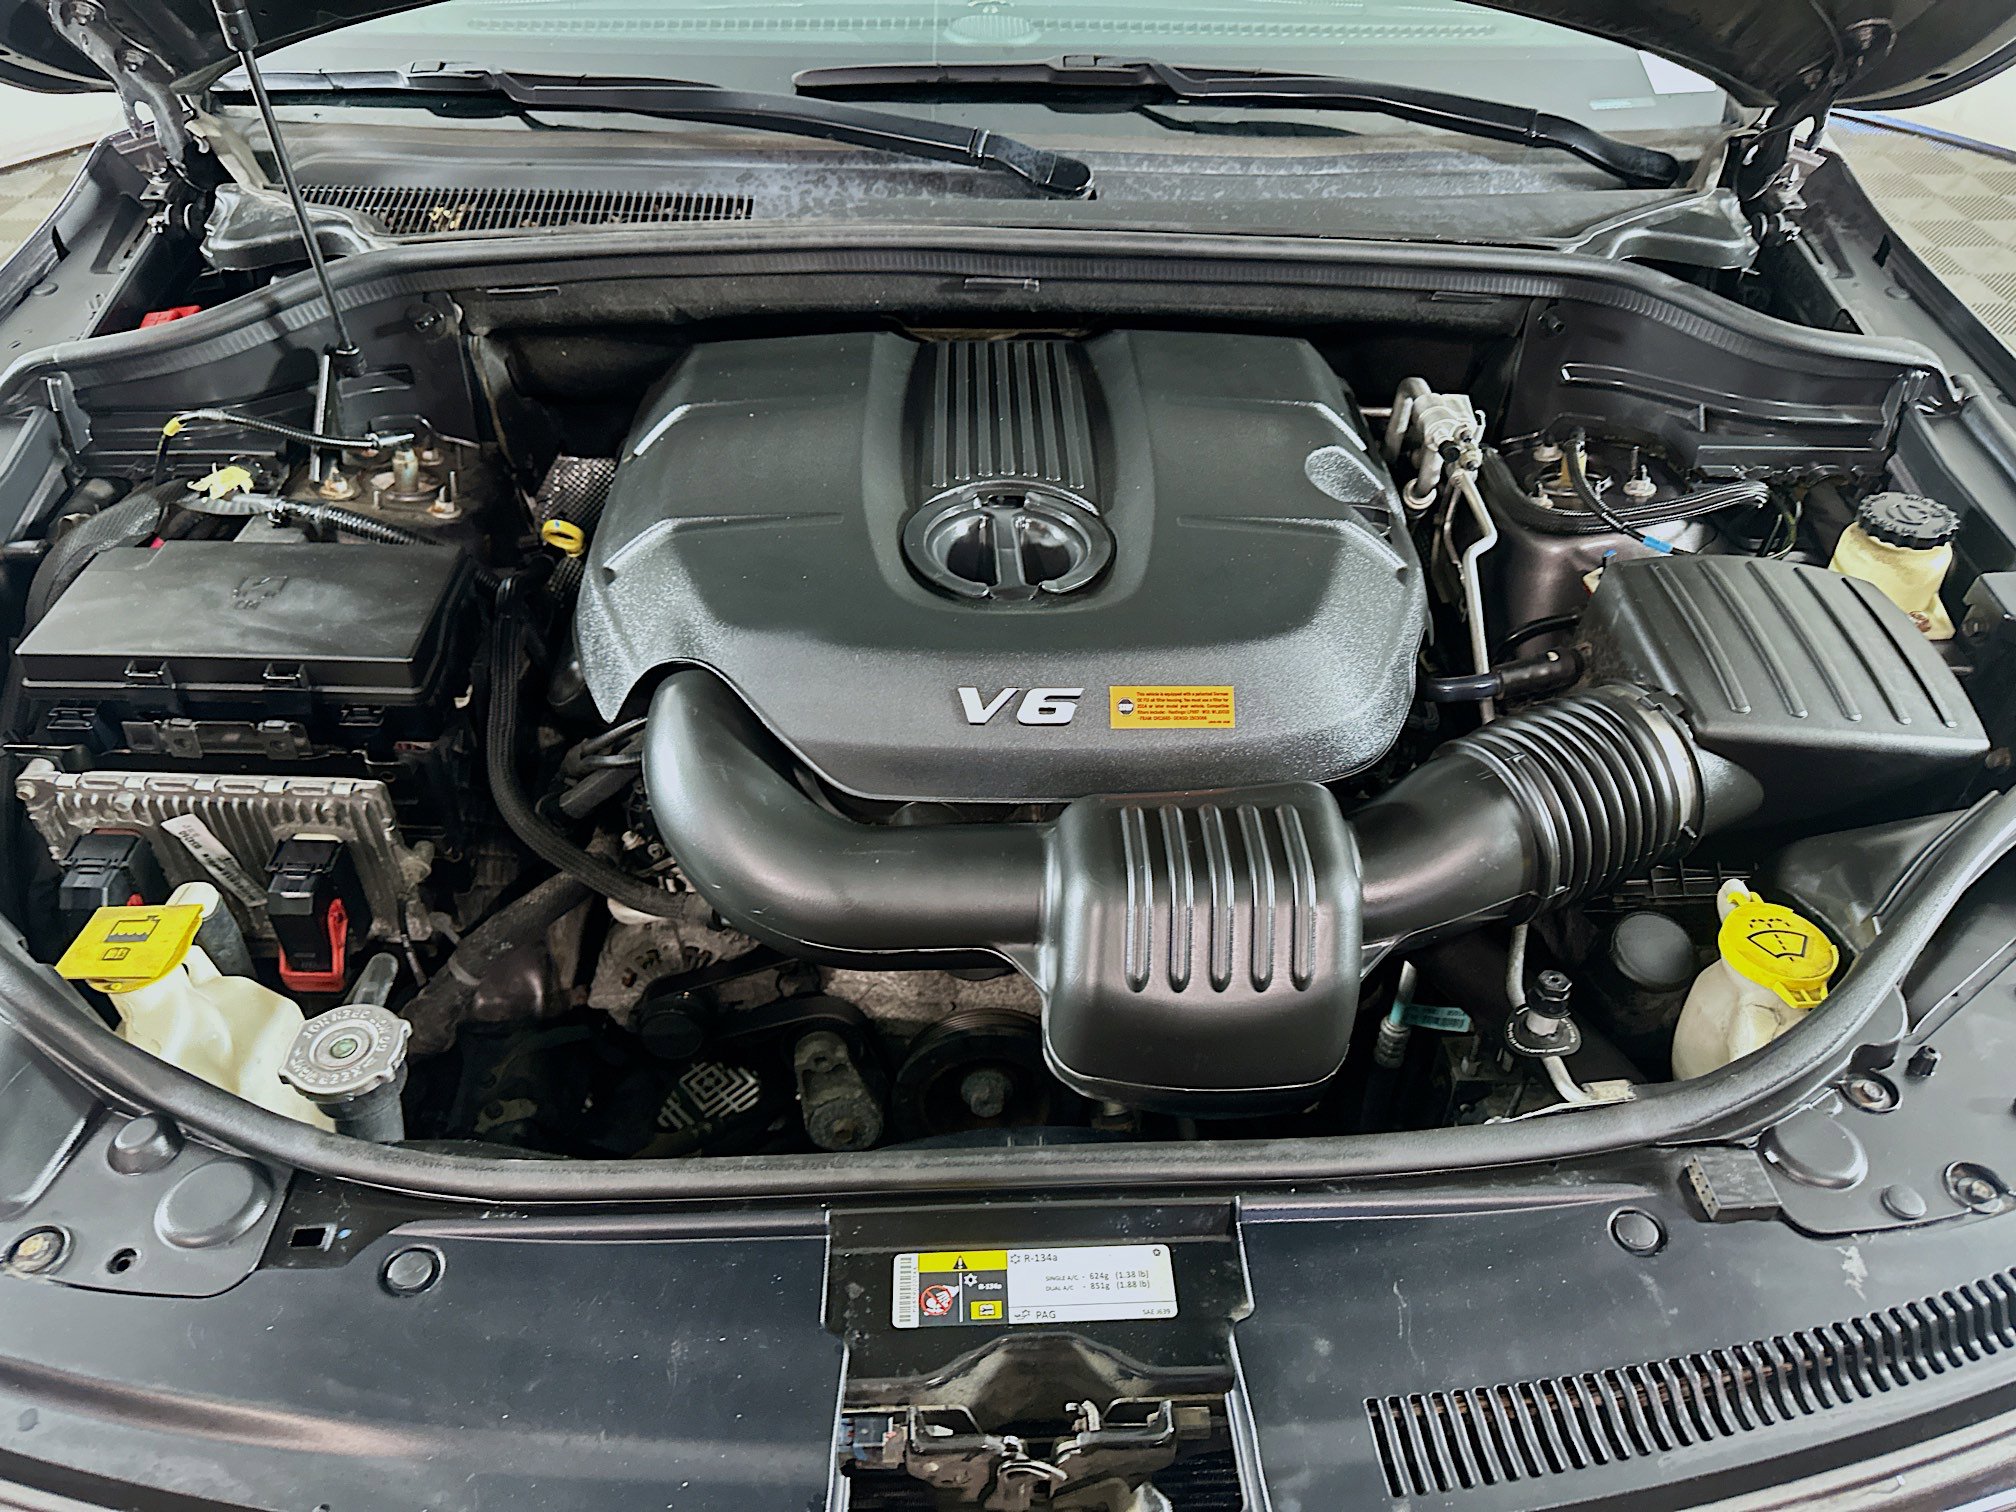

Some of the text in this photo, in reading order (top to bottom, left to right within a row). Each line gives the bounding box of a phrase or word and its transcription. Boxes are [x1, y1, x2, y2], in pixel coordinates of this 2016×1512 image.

[957, 687, 1085, 725] V6
[1024, 1253, 1058, 1263] R-134a
[1089, 1272, 1109, 1281] 624g
[1115, 1271, 1136, 1280] (1.38
[1090, 1282, 1110, 1291] 851g
[1035, 1310, 1056, 1319] PAG
